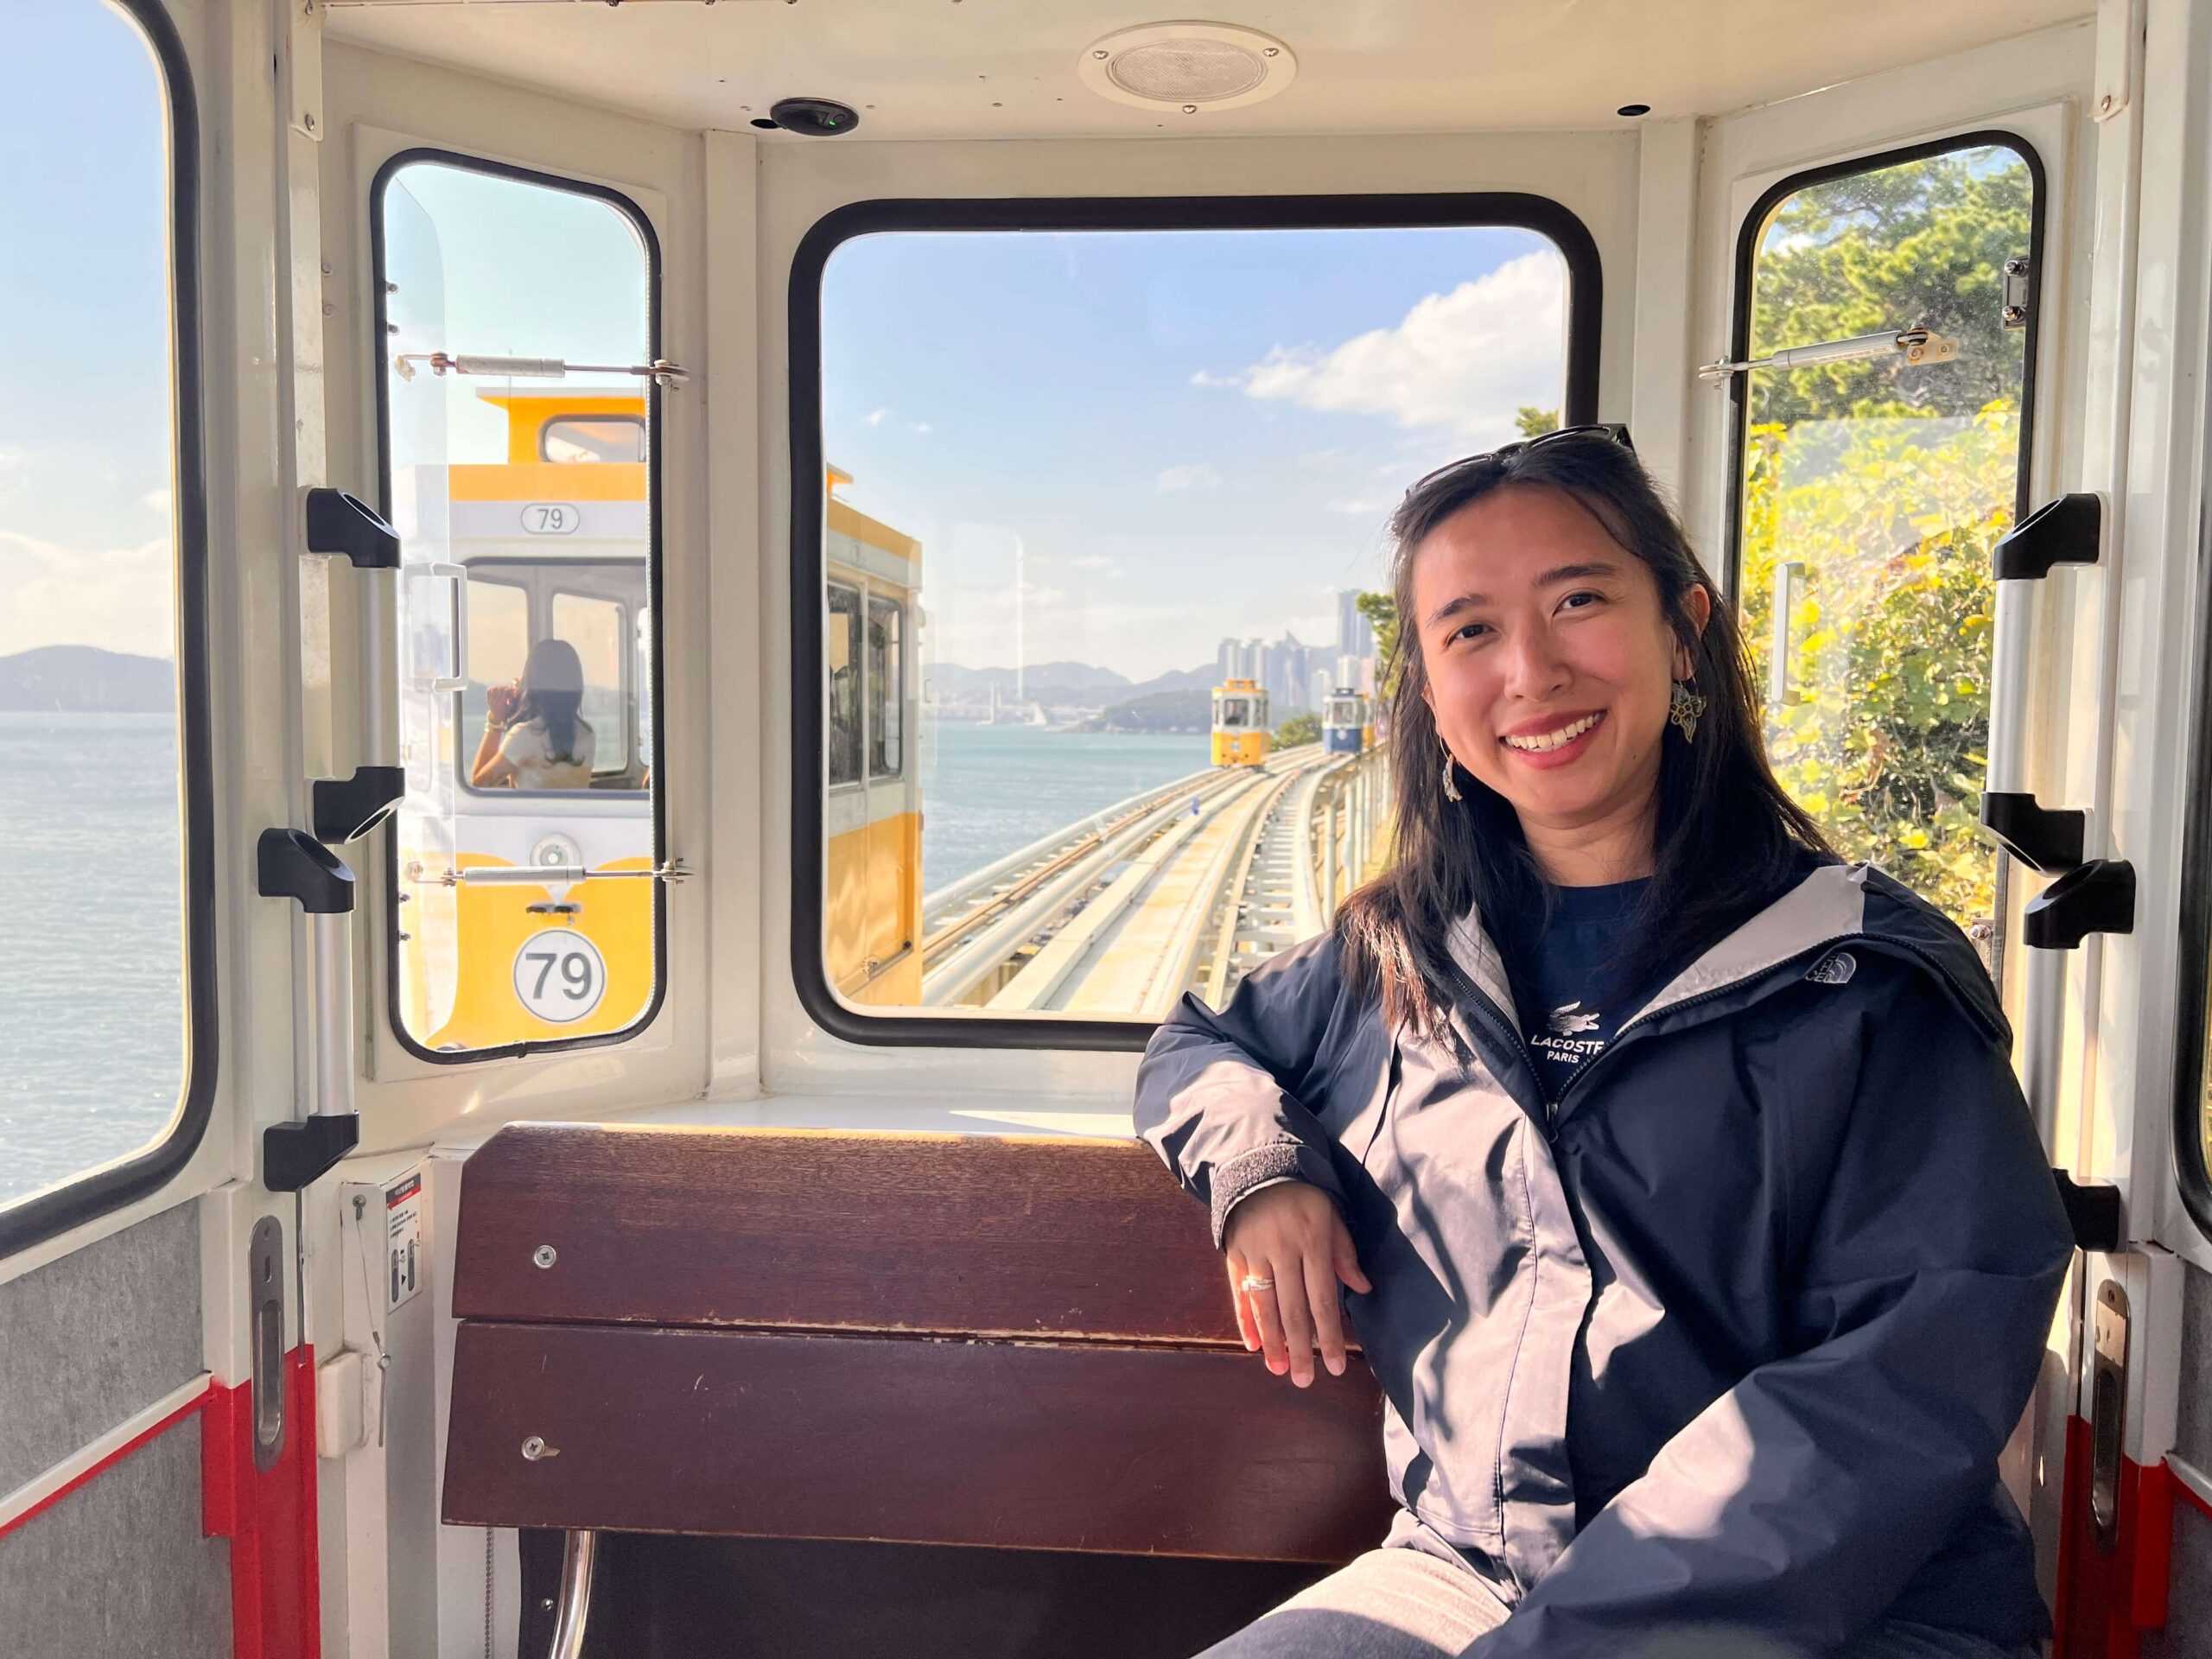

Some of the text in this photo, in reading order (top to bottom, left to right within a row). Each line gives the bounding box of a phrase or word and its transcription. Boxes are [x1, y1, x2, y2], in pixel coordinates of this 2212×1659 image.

[537, 508, 563, 530] 79
[525, 952, 592, 1000] 79
[1547, 1051, 1580, 1064] PARIS
